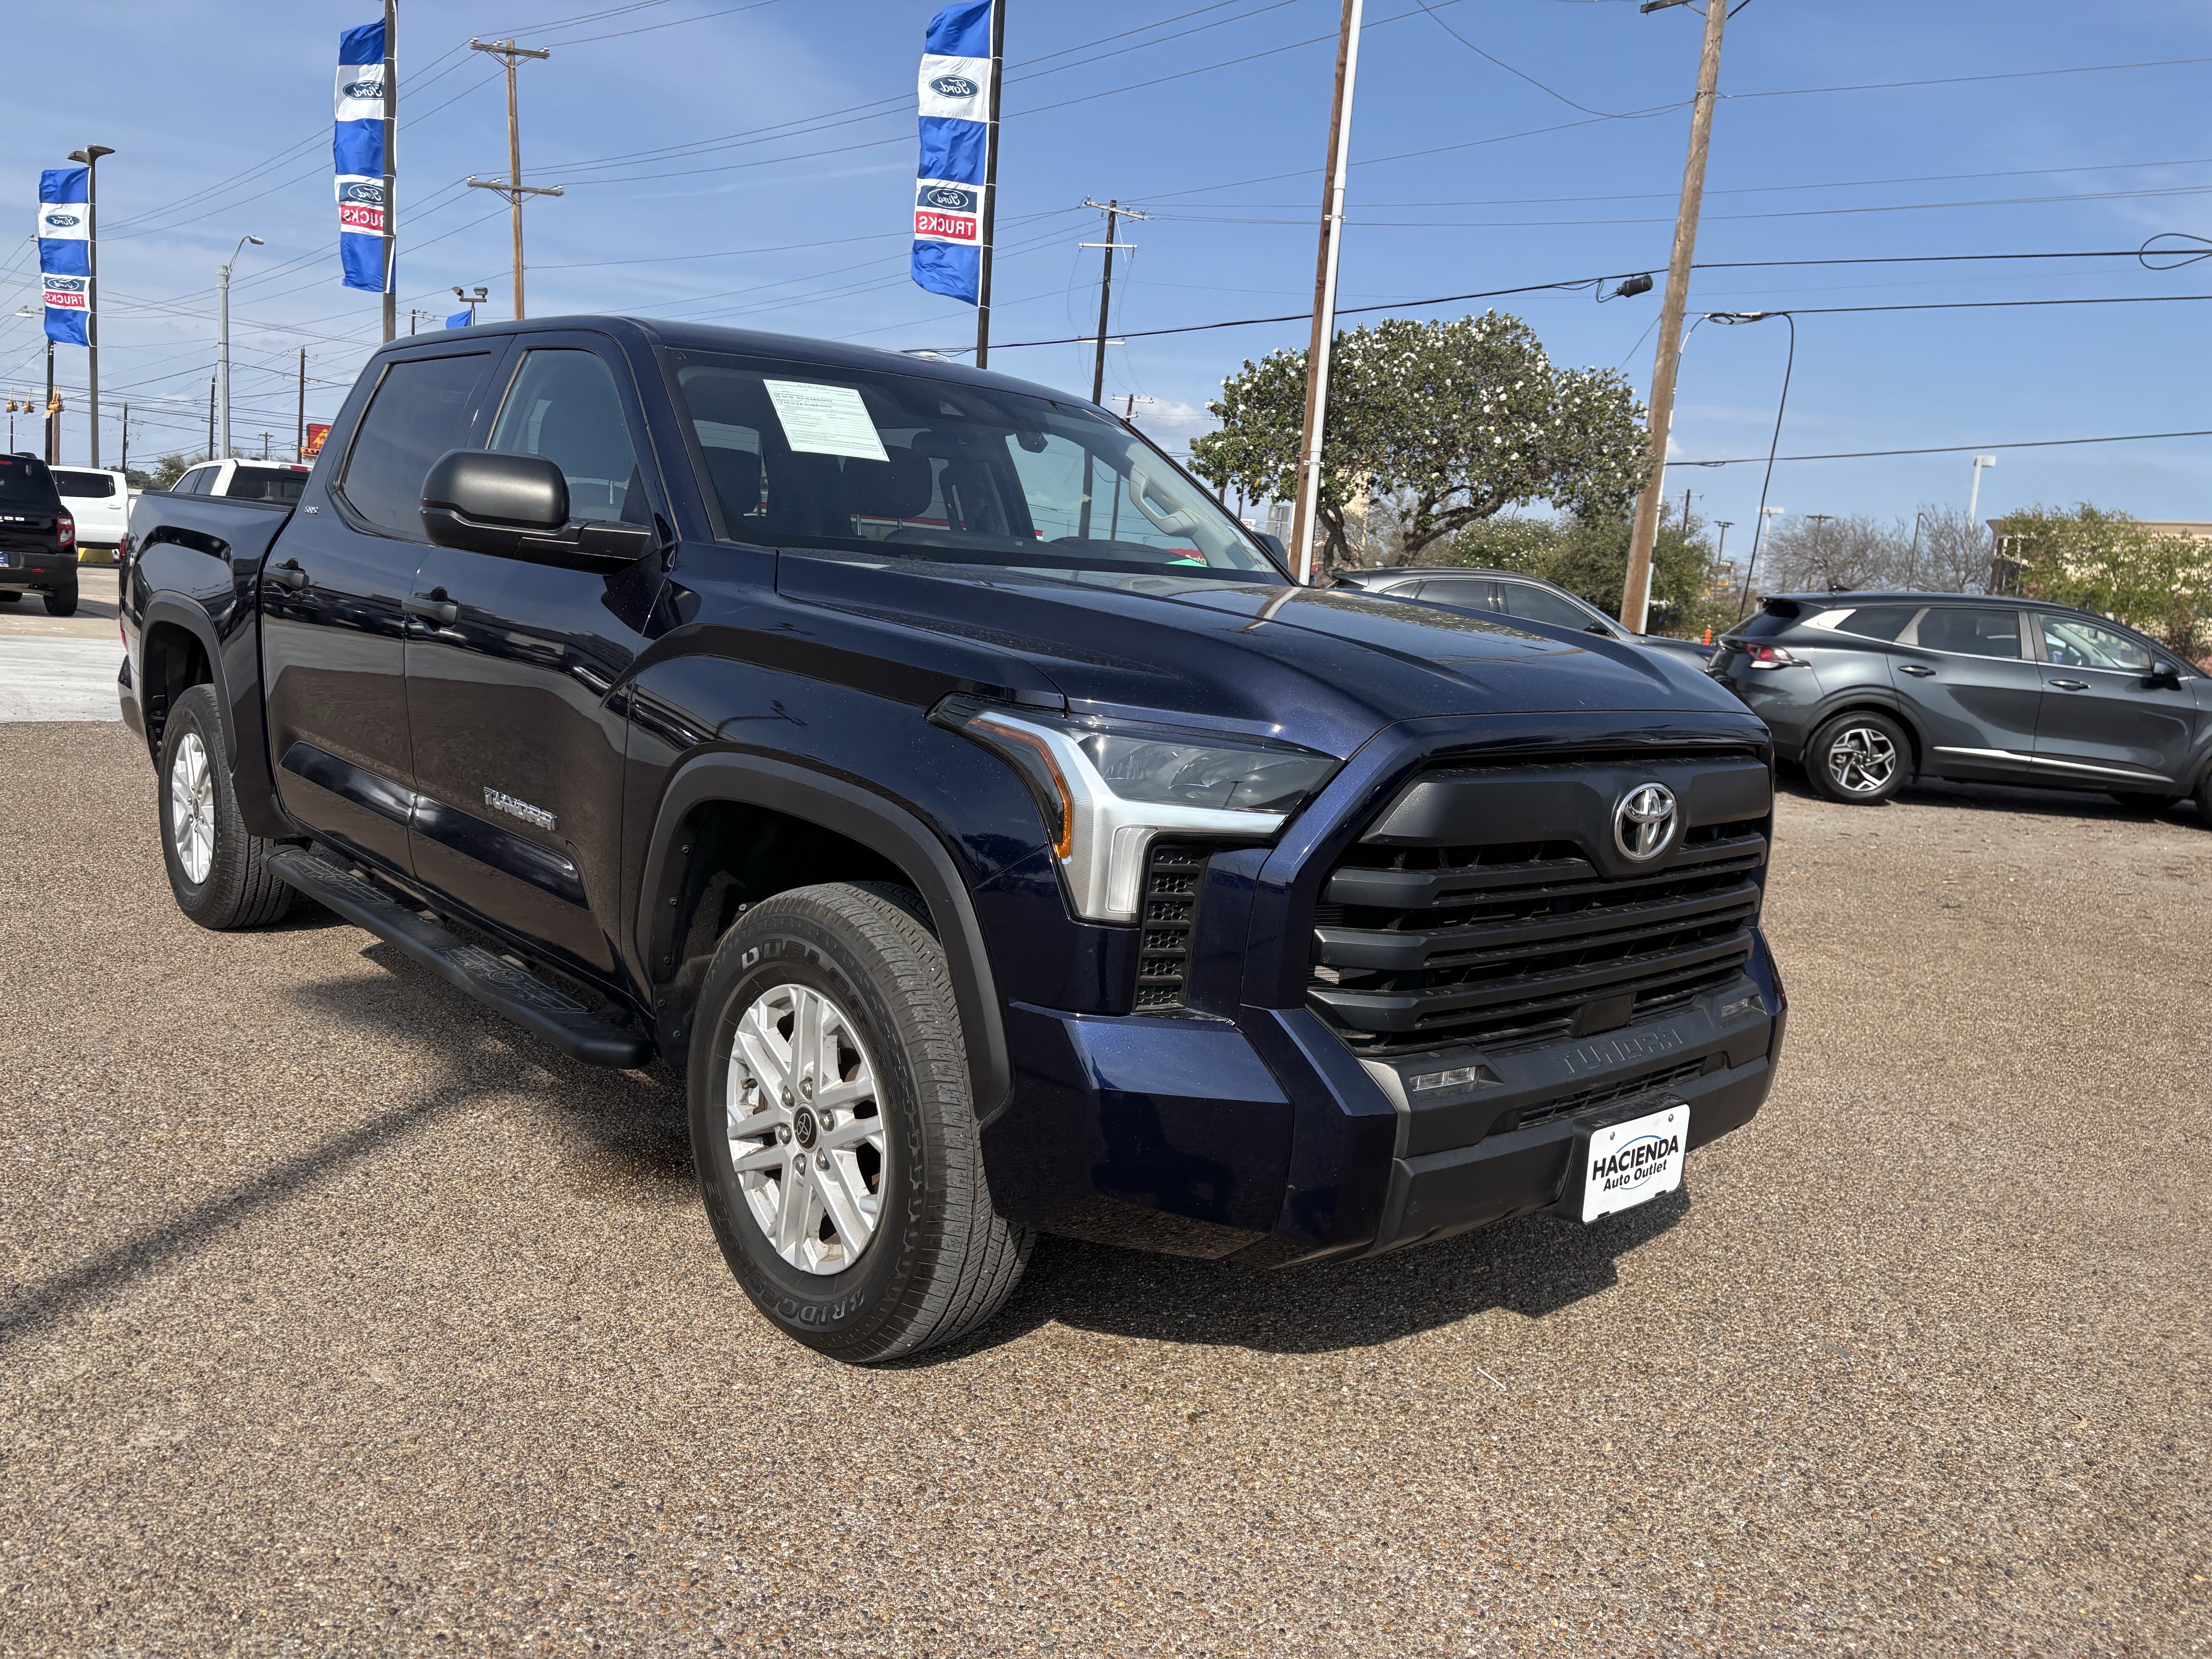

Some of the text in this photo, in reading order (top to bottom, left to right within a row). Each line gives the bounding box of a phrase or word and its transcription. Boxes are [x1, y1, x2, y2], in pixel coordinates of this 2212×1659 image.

[483, 786, 558, 831] TUNDRA
[1551, 1027, 1683, 1074] TUNDRA
[1592, 1135, 1679, 1181] HACIENDA
[1603, 1159, 1667, 1192] Auto Outlet
